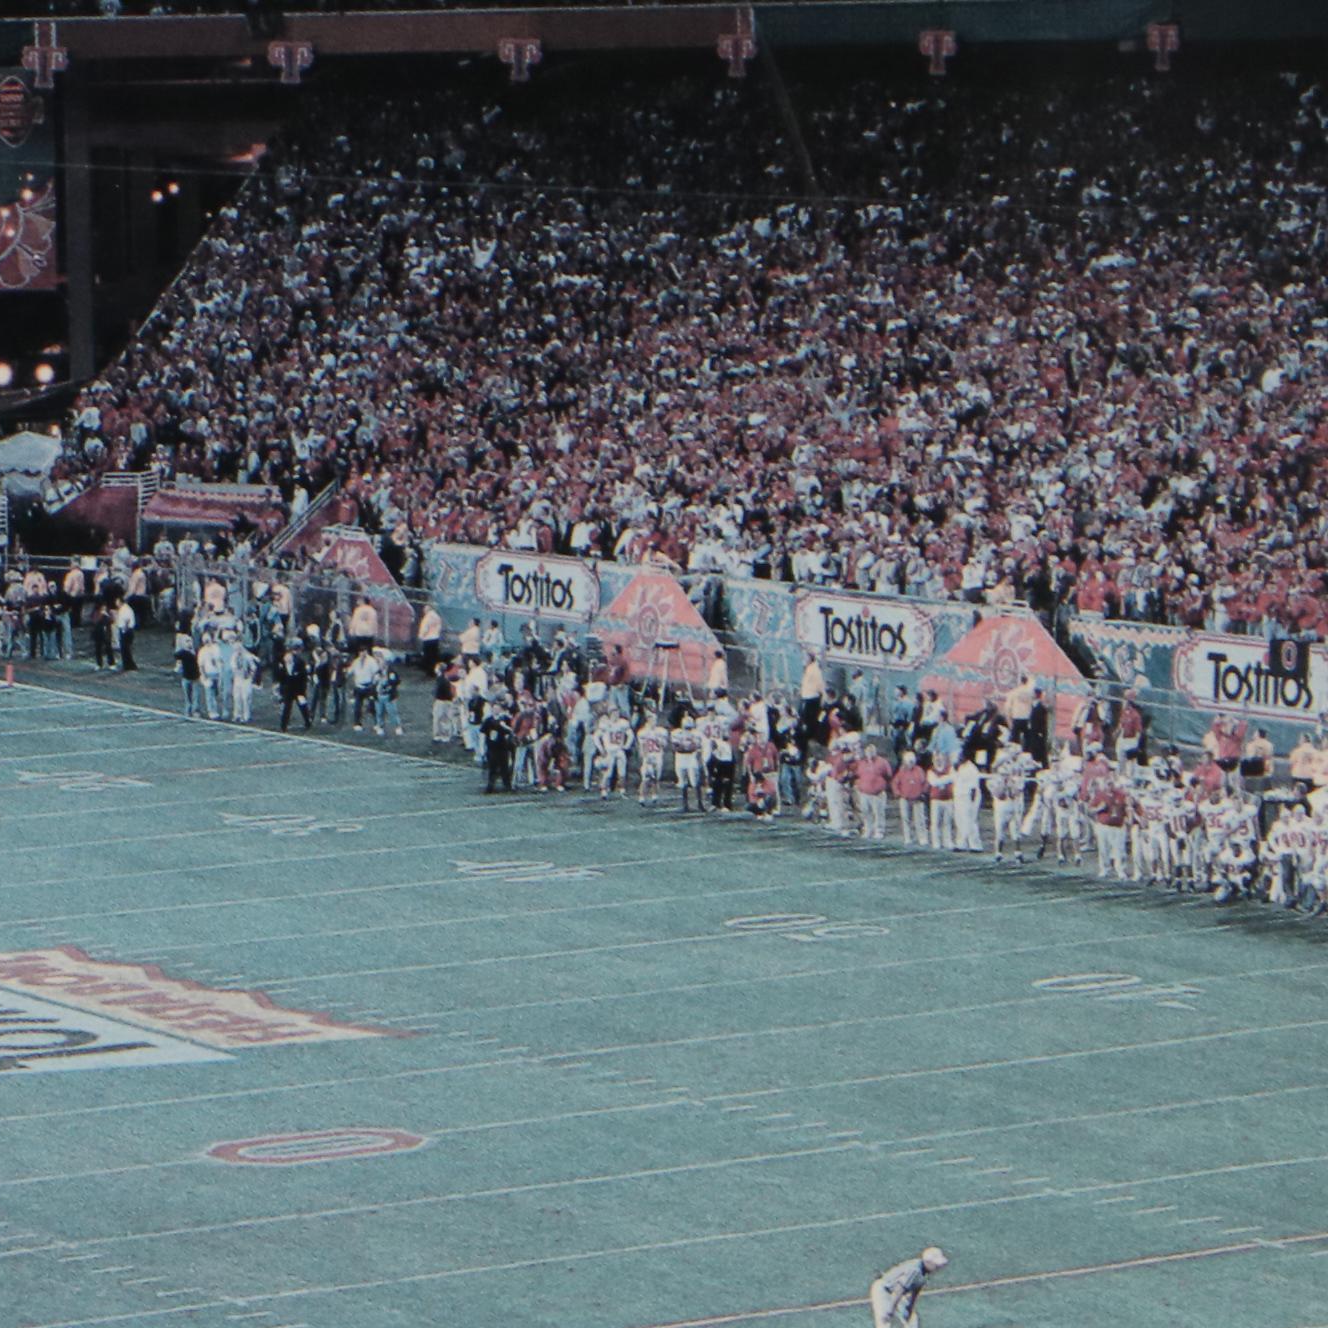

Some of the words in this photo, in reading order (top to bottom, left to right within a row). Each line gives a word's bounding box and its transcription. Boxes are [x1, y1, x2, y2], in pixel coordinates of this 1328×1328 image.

[497, 560, 574, 610] Tostitos
[818, 605, 907, 657] Tostitos
[1206, 651, 1313, 710] Tostitos
